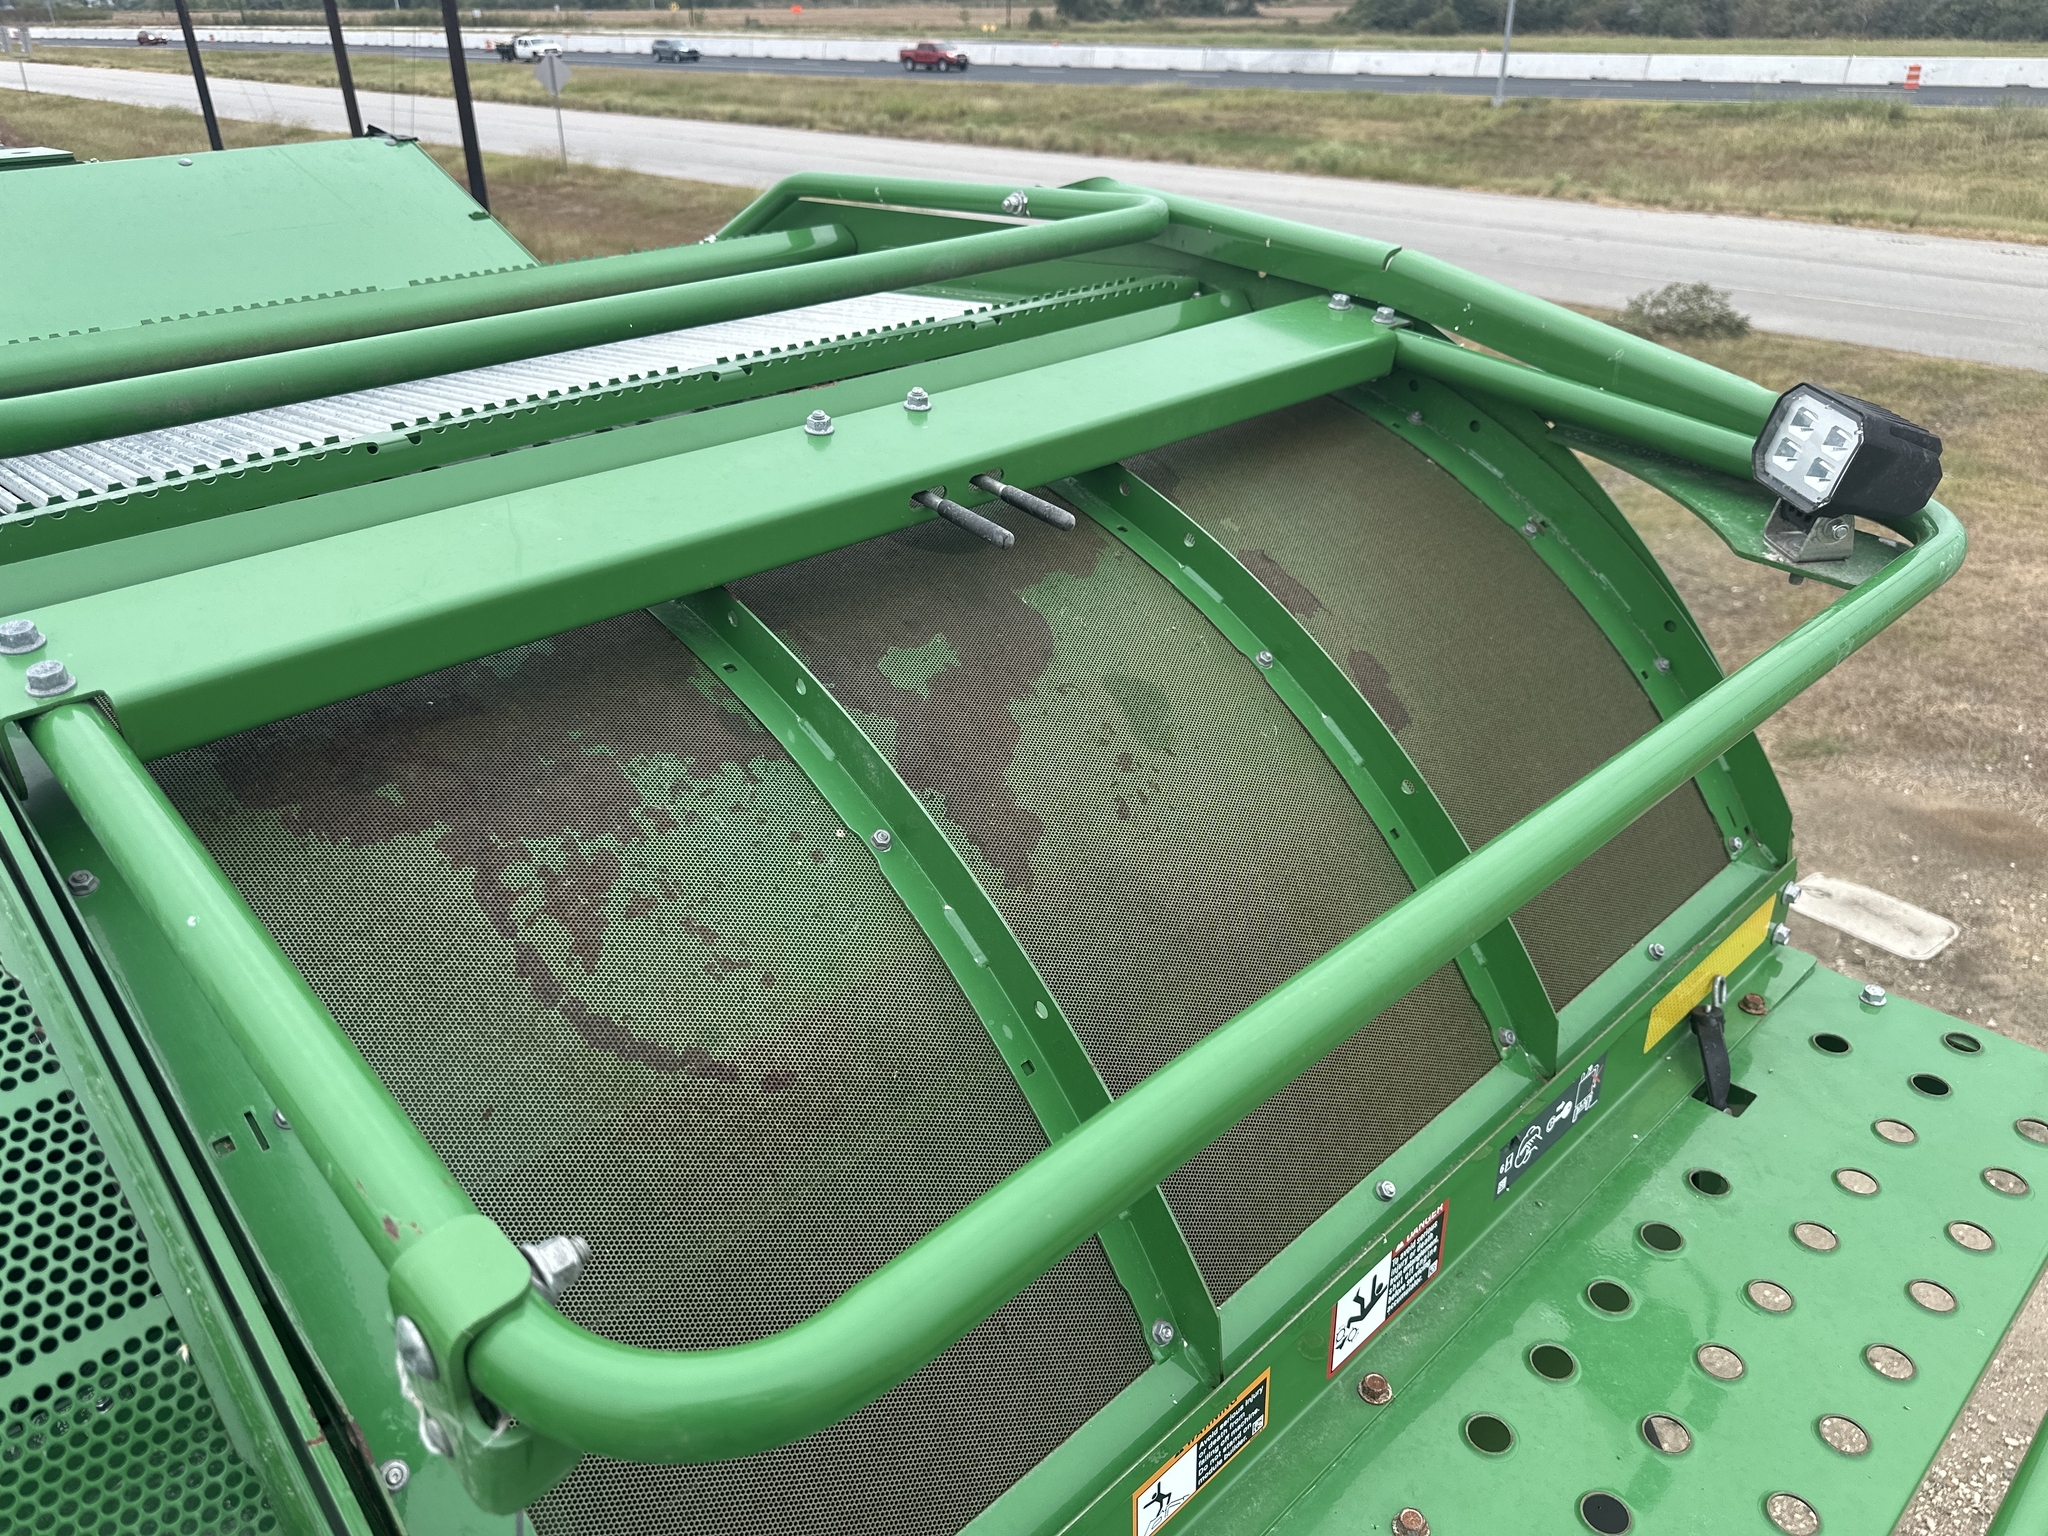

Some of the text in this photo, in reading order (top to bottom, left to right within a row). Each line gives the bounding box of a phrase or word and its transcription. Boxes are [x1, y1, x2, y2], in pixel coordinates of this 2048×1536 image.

[1391, 1232, 1433, 1277] injury or death
[1392, 1220, 1438, 1267] To avoid serious
[1388, 1259, 1431, 1304] before servicing
[1389, 1245, 1437, 1296] shut off engine
[1390, 1270, 1402, 1286] from
[1198, 1445, 1219, 1467] falling
[1220, 1433, 1229, 1446] off
[1231, 1408, 1260, 1437] machine.
[1199, 1427, 1218, 1450] Avoid
[1219, 1404, 1244, 1430] serious
[1245, 1385, 1263, 1406] injury
[1199, 1412, 1245, 1458] or death from
[1198, 1436, 1247, 1485] module builder.
[1199, 1422, 1251, 1476] Do not stand on
